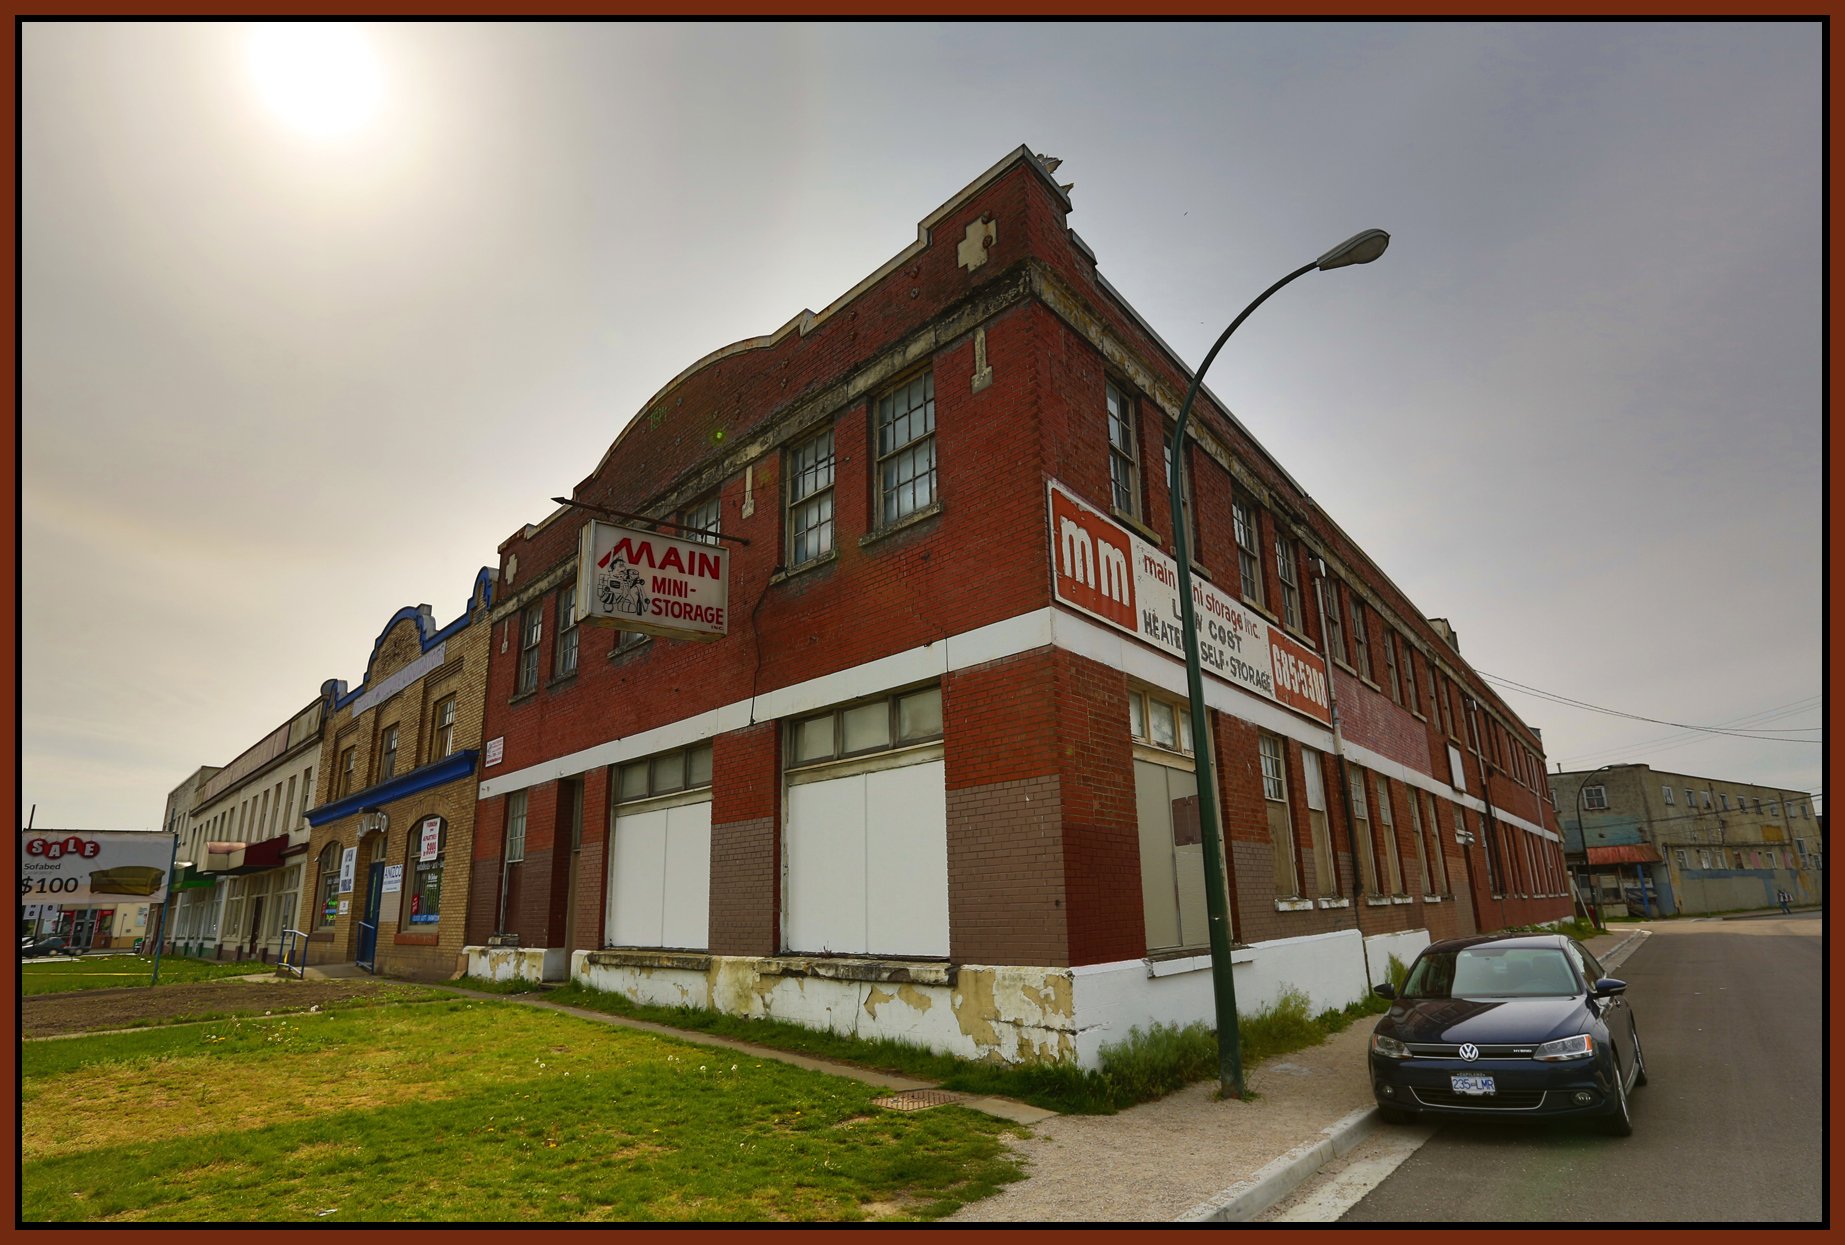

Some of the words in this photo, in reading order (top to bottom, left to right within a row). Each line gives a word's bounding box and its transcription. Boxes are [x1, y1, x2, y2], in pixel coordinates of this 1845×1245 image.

[597, 537, 720, 580] MAIN
[652, 575, 697, 599] MINI-
[1143, 554, 1176, 590] main
[1205, 592, 1244, 633] storage
[1243, 611, 1261, 640] inc.
[651, 597, 724, 626] STORAGE
[1208, 619, 1242, 653] COST
[31, 839, 95, 857] SALE
